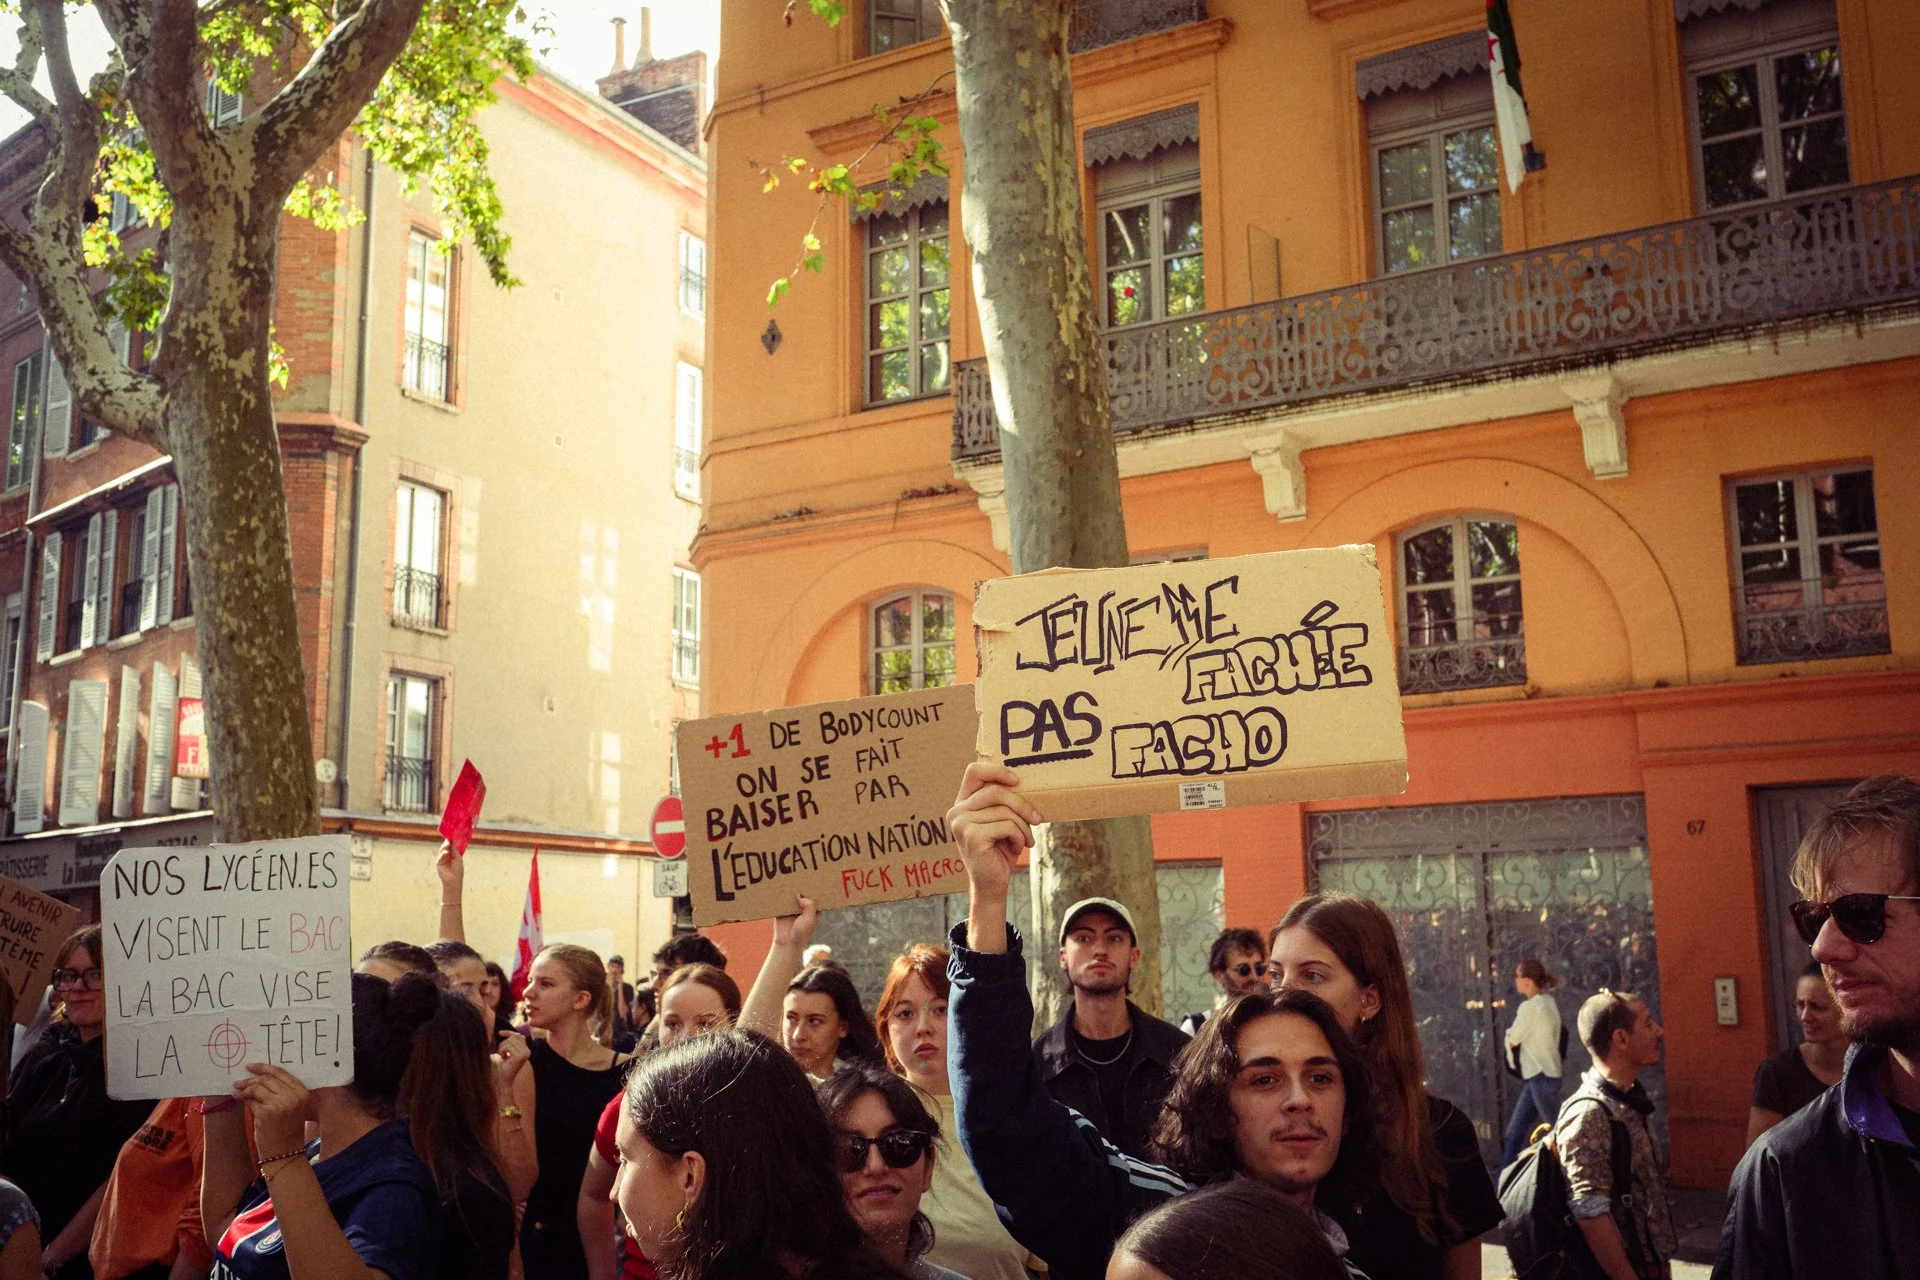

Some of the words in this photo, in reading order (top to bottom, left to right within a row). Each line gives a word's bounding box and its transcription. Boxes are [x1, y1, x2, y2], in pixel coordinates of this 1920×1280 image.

[1015, 575, 1240, 675] JEUNESSE
[1182, 600, 1372, 704] FACHÉE
[704, 722, 751, 759] +1
[769, 719, 801, 750] DE
[819, 702, 944, 744] BODYCOUNT
[999, 690, 1103, 756] PAS
[1110, 706, 1288, 778] FACHO
[735, 765, 778, 798] ON
[800, 754, 831, 785] SE
[706, 788, 819, 843] BAISER
[855, 774, 910, 804] PAR
[1687, 820, 1705, 835] 67
[115, 855, 185, 899] NOS
[203, 848, 338, 891] LYCÉEN.ES
[841, 863, 894, 898] FUCK
[905, 856, 965, 888] MACRO
[10, 890, 63, 926] AVENIR
[113, 915, 227, 963] VISENT
[241, 917, 271, 950] LE
[289, 912, 343, 954] BAC
[118, 980, 154, 1018] LA
[171, 971, 234, 1014] BAC
[259, 970, 332, 1008] VISE
[135, 1034, 182, 1078] LA
